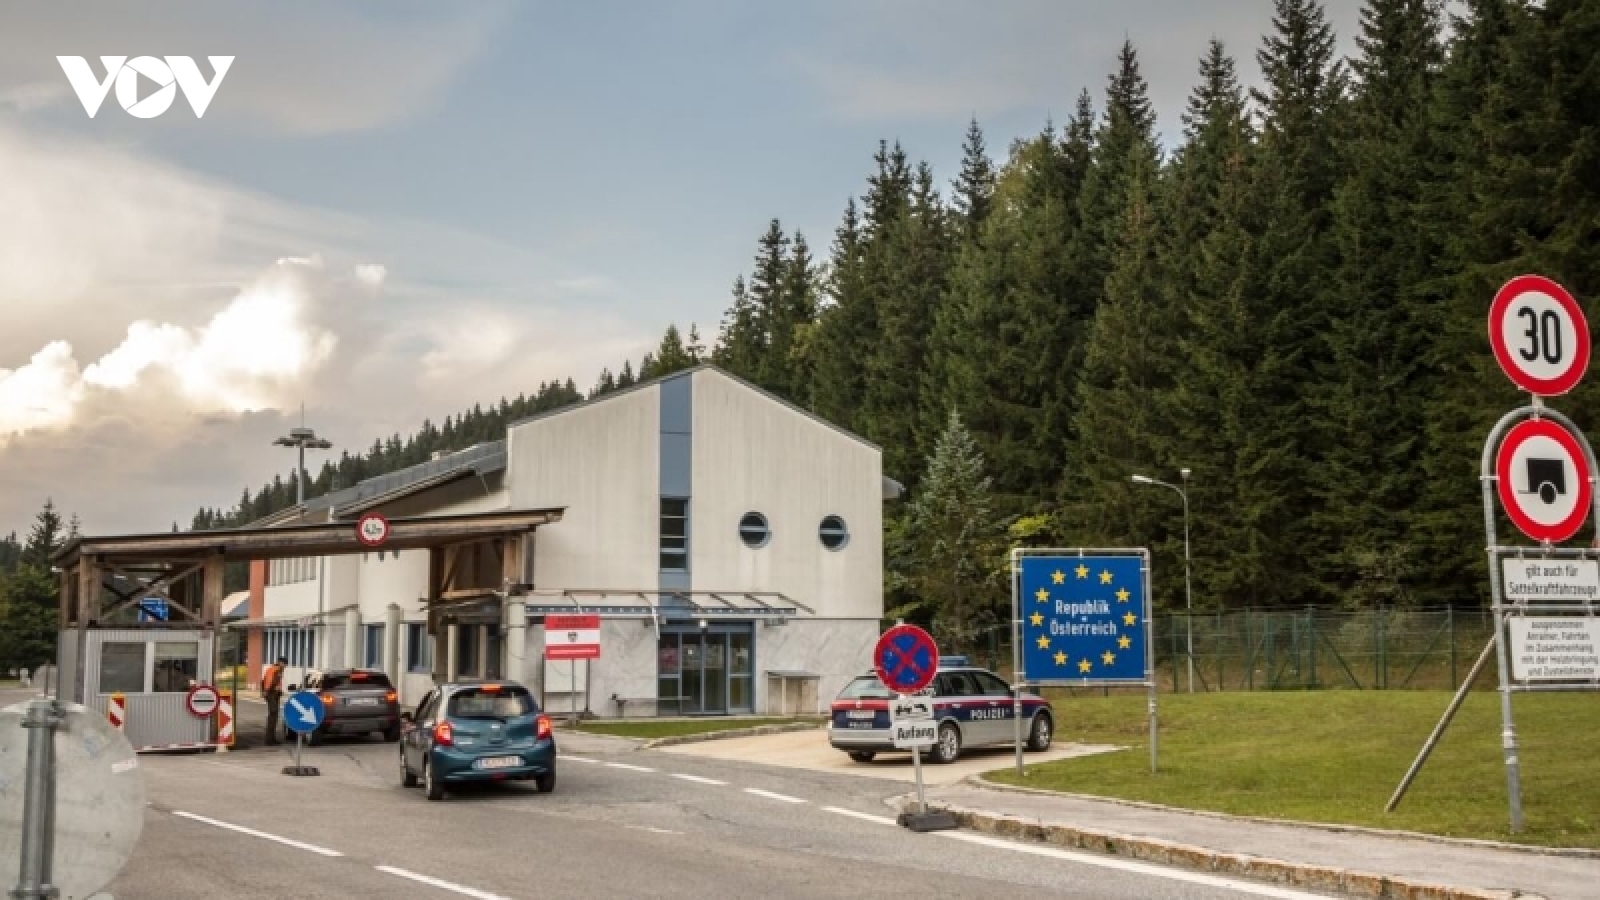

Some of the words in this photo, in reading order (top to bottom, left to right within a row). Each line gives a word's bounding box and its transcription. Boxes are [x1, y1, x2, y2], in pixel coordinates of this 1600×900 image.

[1517, 306, 1563, 365] 30
[1525, 564, 1541, 579] gilt
[1544, 566, 1563, 577] auch
[1565, 564, 1578, 577] für
[1055, 599, 1110, 618] Republik
[1049, 618, 1117, 636] Österreich
[970, 708, 1005, 720] POLIZEI
[897, 726, 935, 740] Anfang
